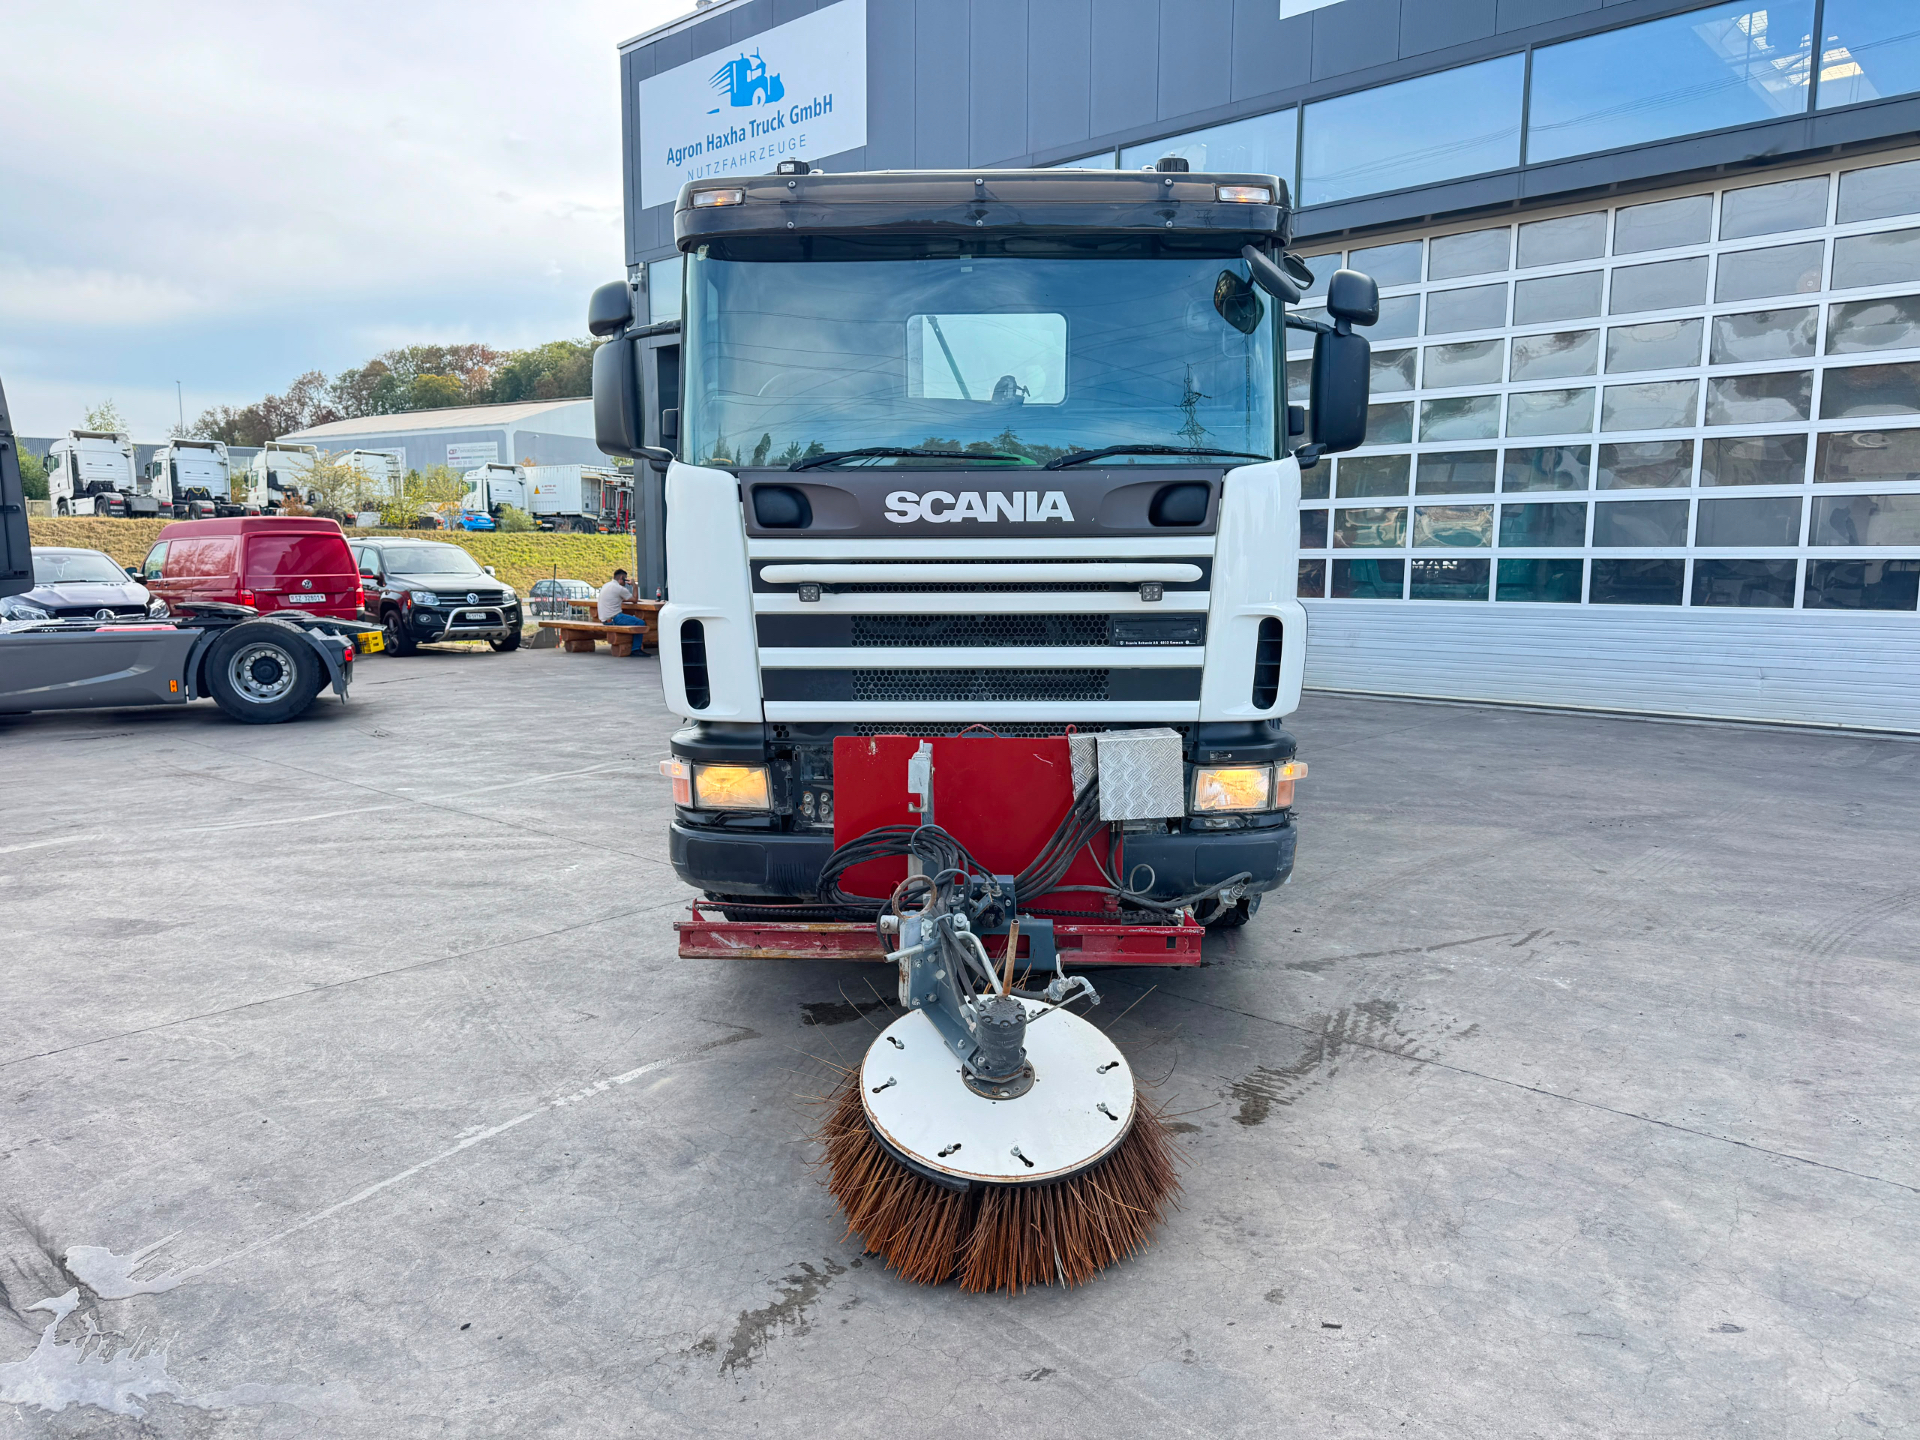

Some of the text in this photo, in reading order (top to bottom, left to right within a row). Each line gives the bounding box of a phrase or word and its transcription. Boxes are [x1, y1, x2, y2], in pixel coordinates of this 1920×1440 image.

[667, 93, 833, 167] Agron Haxha Truck GmbH
[687, 134, 807, 182] NUTZFAHRZEUGE
[884, 490, 1075, 523] SCANIA
[1412, 560, 1458, 570] MAN
